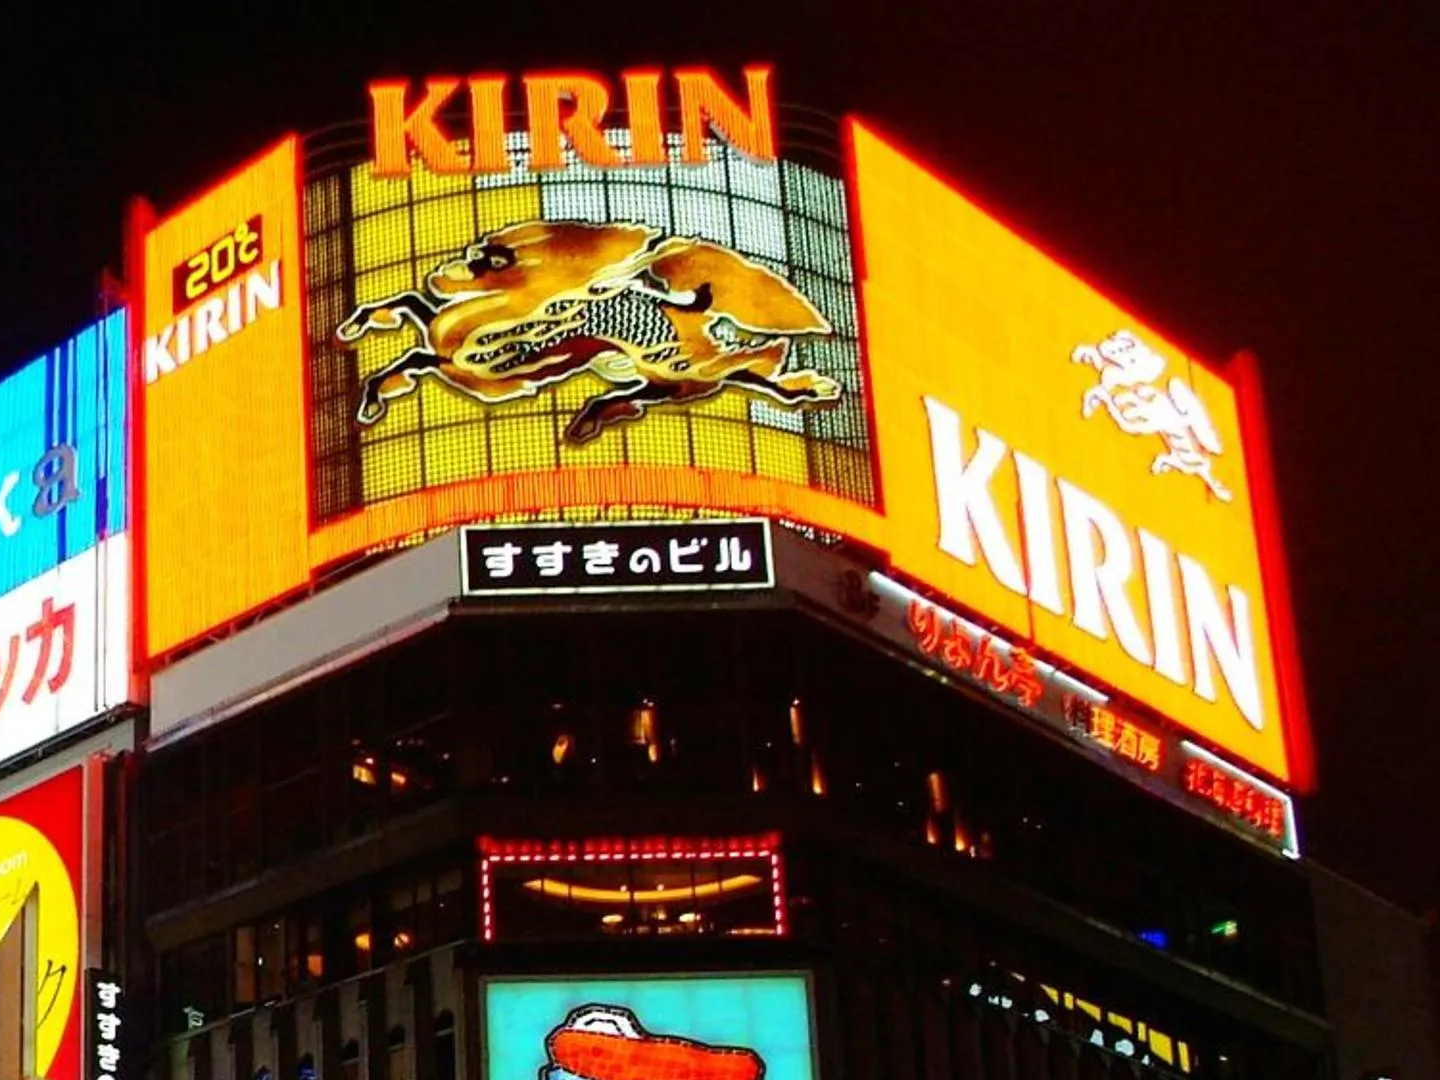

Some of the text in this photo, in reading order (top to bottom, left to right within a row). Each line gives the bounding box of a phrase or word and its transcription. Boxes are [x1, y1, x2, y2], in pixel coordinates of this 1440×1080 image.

[368, 65, 779, 179] KIRIN
[145, 260, 283, 384] KIRIN
[482, 536, 752, 577] すすきのビル
[921, 395, 1265, 732] KIRIN
